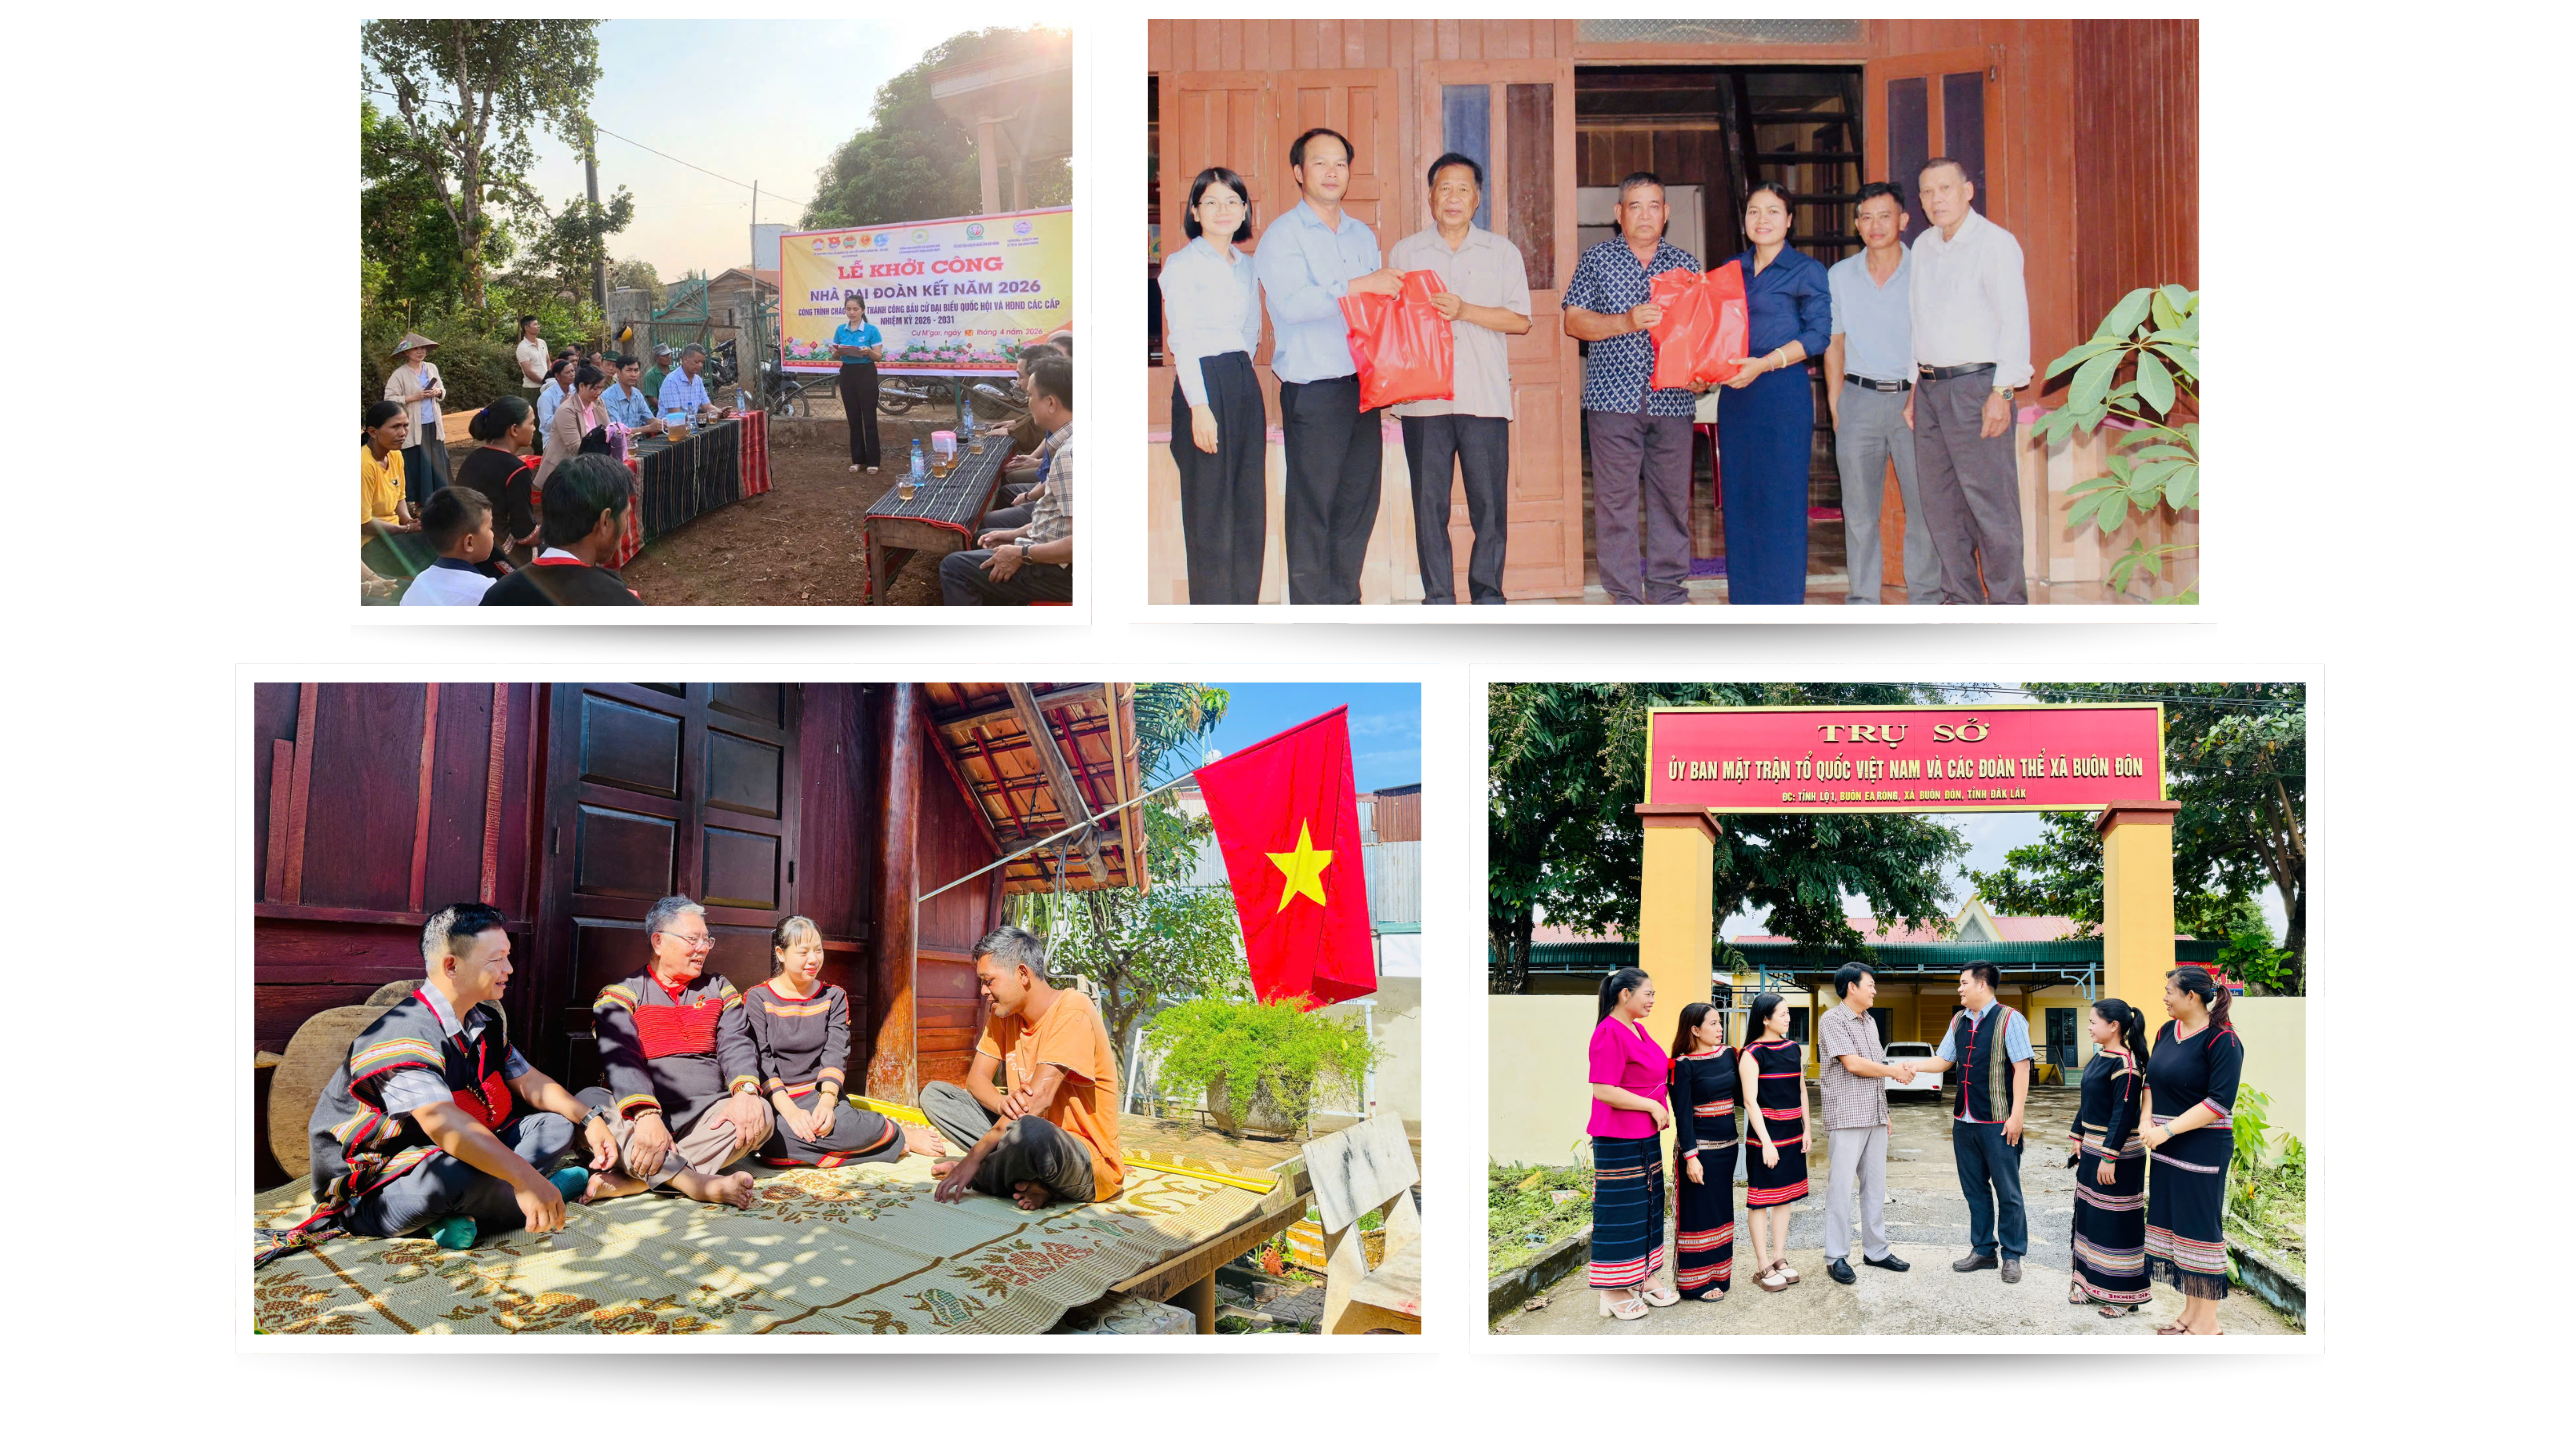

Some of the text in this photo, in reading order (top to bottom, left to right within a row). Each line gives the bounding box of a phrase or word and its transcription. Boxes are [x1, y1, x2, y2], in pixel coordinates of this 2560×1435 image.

[837, 256, 1004, 280] LỄ KHỞI CÔNG
[810, 287, 839, 301] NHÀ
[873, 283, 917, 298] ĐOÀN
[923, 279, 949, 296] KẾT
[954, 280, 993, 295] NĂM
[998, 280, 1041, 294] 2026
[798, 306, 813, 316] CÔNG
[814, 306, 830, 316] TRÌNH
[867, 305, 886, 314] THÀNH
[888, 304, 904, 314] CÔNG
[931, 304, 942, 314] ĐẠI
[944, 300, 958, 311] BIỂU
[960, 300, 979, 312] QUỐC
[980, 300, 992, 312] HỘI
[994, 300, 1003, 310] VÀ
[1005, 301, 1025, 310] HĐND
[1028, 299, 1043, 310] CÁC
[1045, 297, 1060, 309] CẤP
[880, 315, 902, 327] NHIỆM
[903, 315, 913, 325] KỲ
[914, 316, 931, 325] 2026
[938, 316, 954, 324] 2031
[944, 329, 962, 337] ngày
[976, 328, 997, 337] tháng
[1817, 717, 1990, 749] TRỤ SỞ
[1668, 748, 2143, 784] ỦY BAN MẶT TRẬN TỔ QUỐC VIỆT NAM VÀ CÁC ĐOÀN THỂ XÃ BUÔN ĐÔN
[1782, 792, 1796, 802] ĐC:
[1798, 789, 1816, 802] TỈNH
[1839, 789, 1862, 802] BUÔN
[1904, 789, 1915, 801] XÃ
[1919, 787, 1940, 801] BUÔN
[1944, 787, 1964, 801] ĐÔN,
[1967, 786, 1987, 800] TỈNH
